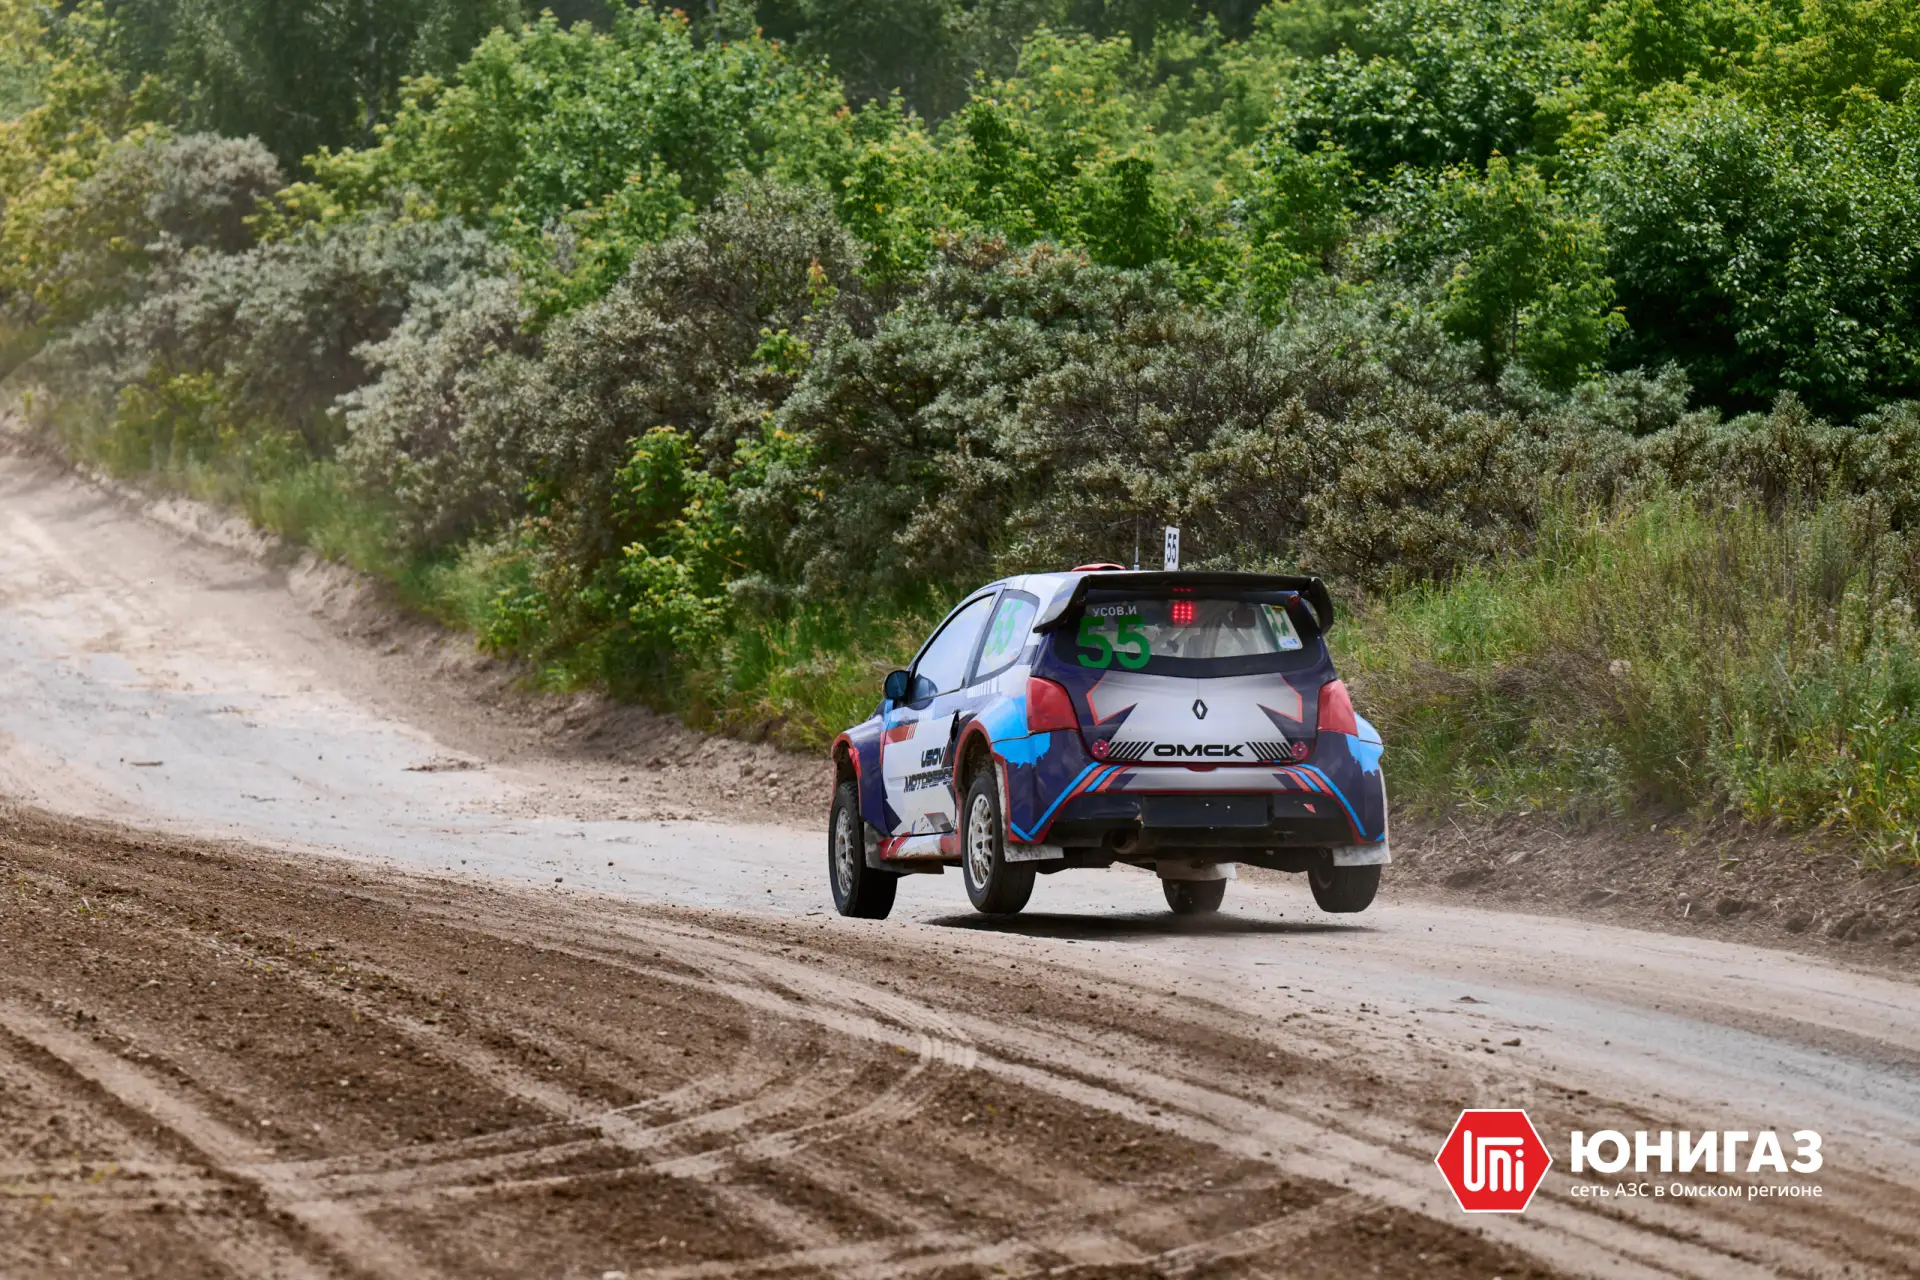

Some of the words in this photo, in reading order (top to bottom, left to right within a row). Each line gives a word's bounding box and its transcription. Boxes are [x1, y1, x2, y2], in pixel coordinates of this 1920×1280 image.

[1167, 533, 1177, 564] 55
[1092, 605, 1137, 617] УСОВ.И
[1077, 615, 1150, 669] 55
